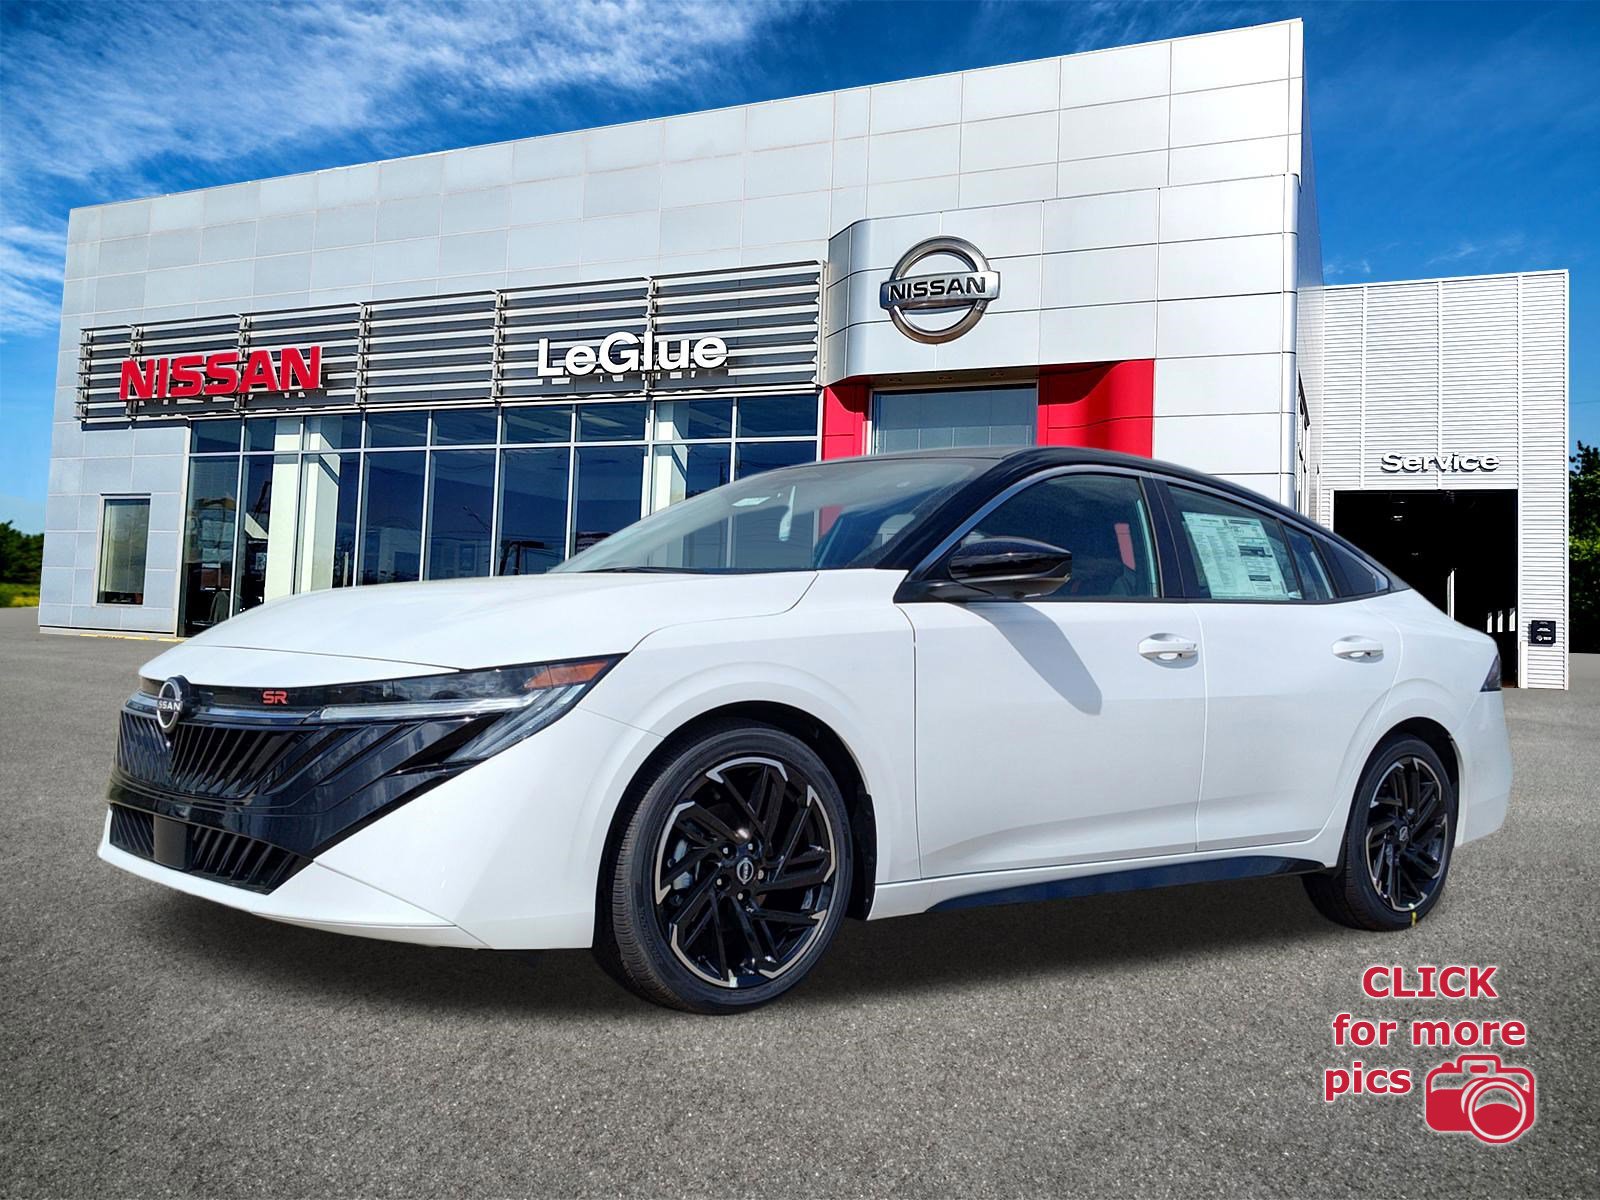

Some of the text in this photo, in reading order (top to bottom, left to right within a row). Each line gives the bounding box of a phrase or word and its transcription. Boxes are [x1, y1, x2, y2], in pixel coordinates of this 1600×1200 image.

[888, 276, 986, 301] NISSAN
[537, 331, 729, 377] LeGlue
[119, 345, 323, 400] NISSAN
[1381, 450, 1500, 473] Service
[262, 690, 288, 704] SR
